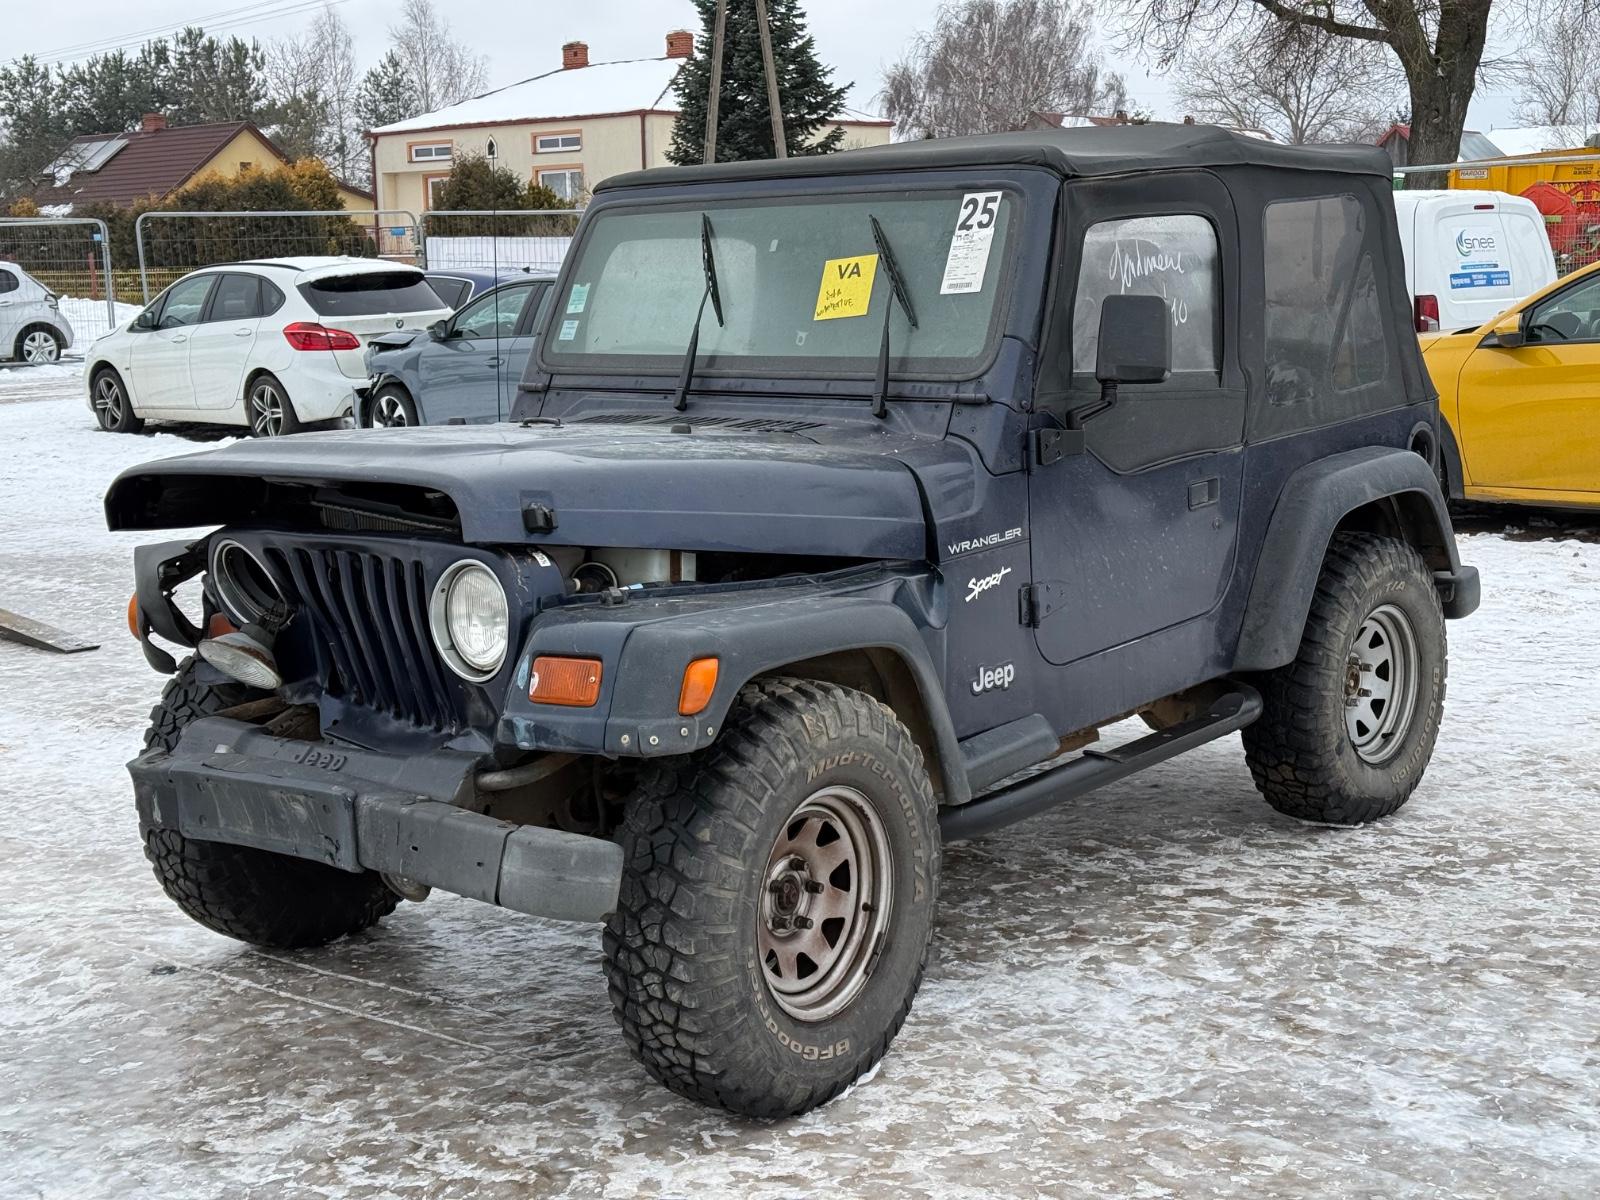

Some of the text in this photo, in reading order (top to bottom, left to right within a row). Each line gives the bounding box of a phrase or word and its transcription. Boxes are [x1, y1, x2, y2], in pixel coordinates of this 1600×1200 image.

[957, 195, 998, 232] 25
[1464, 237, 1496, 249] snee
[838, 262, 862, 280] VA
[948, 527, 1022, 555] WRANGLER
[972, 663, 1015, 693] Jeep
[1391, 667, 1440, 785] BFGoodrich
[293, 746, 348, 772] Jeep
[806, 751, 927, 903] Mud-Terrain T/A
[746, 948, 852, 1061] BFGoodrich
